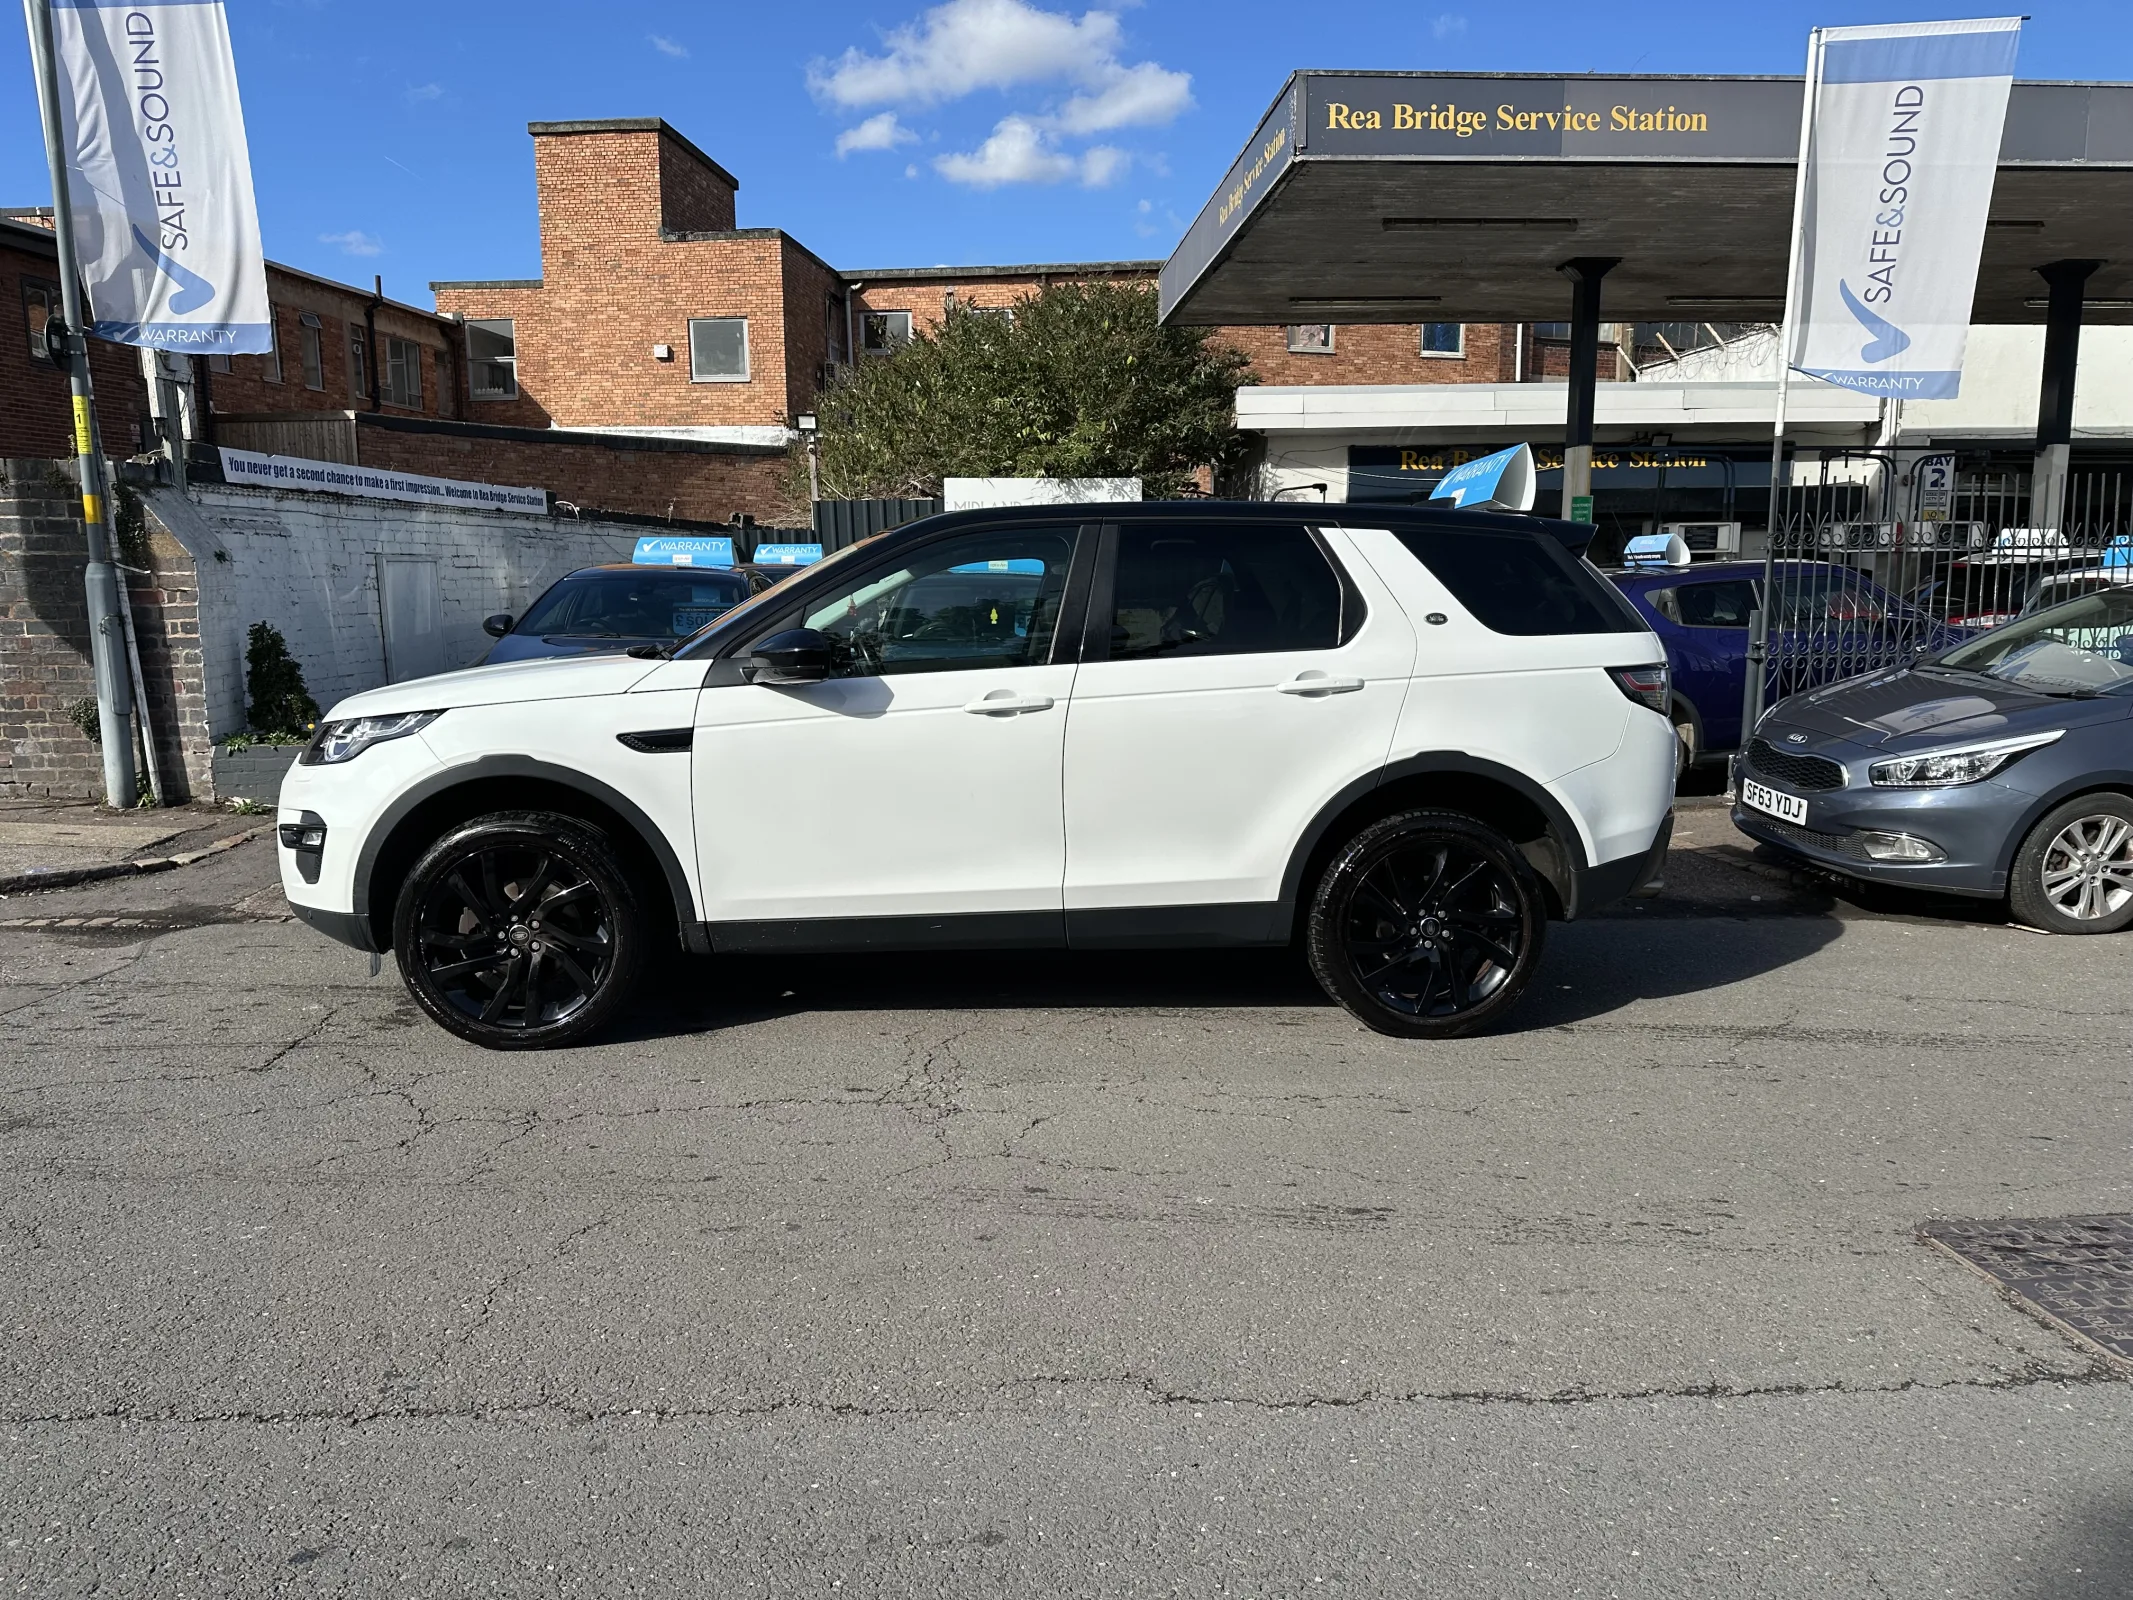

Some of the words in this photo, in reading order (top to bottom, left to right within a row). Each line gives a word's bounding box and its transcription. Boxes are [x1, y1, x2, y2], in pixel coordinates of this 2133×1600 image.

[1326, 103, 1382, 131] Rea
[1391, 103, 1487, 138] Bridge
[1496, 104, 1601, 132] Service
[1610, 104, 1708, 132] Station
[125, 11, 188, 251] SAFE&SOUND
[1228, 183, 1244, 216] Bridge
[1243, 157, 1264, 195] Service
[1263, 127, 1286, 168] Station
[1863, 85, 1924, 304] SAFE&SOUND
[139, 330, 238, 344] WARRANTY
[1832, 373, 1925, 391] WARRANTY
[1400, 450, 1444, 470] Rea
[1537, 450, 1619, 469] Seice
[1451, 453, 1512, 485] WARRANTY
[1925, 456, 1953, 466] BAY
[228, 457, 246, 472] You
[247, 461, 272, 476] never
[273, 464, 288, 479] get
[289, 467, 295, 479] a
[296, 467, 325, 482] second
[326, 469, 354, 486] chance
[354, 473, 363, 487] to
[364, 475, 384, 489] make
[384, 479, 390, 490] a
[390, 478, 405, 492] first
[444, 485, 472, 500] Welcome
[472, 488, 479, 500] to
[479, 490, 490, 501] Rea
[490, 491, 507, 504] Bridge
[507, 493, 526, 505] Service
[527, 494, 544, 507] Station
[1930, 468, 1946, 488] 2
[659, 541, 726, 551] WARRANTY
[772, 546, 818, 554] WARRANTY
[1789, 733, 1804, 742] KIA
[1747, 782, 1772, 809] SF63
[1776, 793, 1801, 818] YDJ
